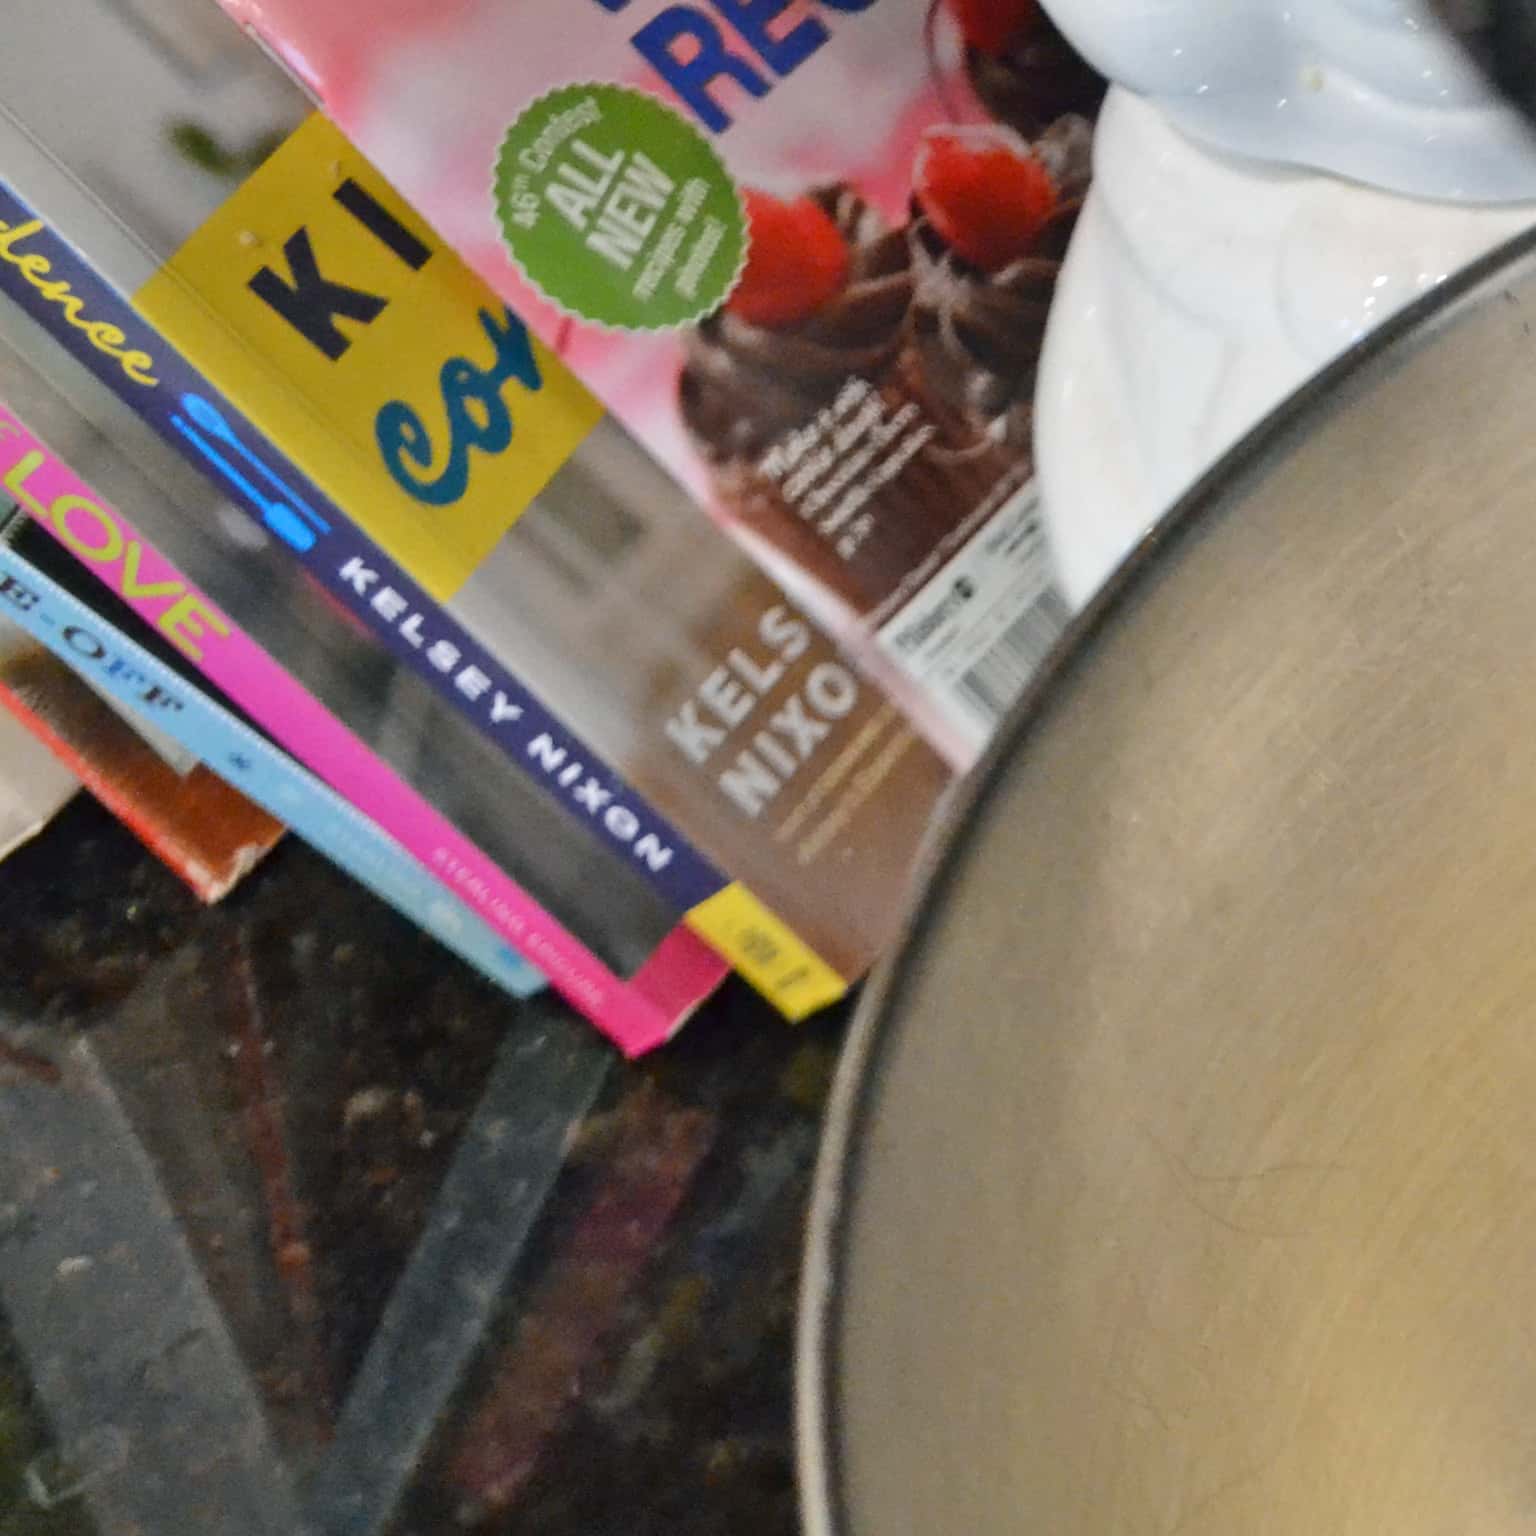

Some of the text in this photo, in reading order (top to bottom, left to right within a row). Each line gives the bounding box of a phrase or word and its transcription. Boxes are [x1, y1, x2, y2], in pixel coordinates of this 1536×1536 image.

[630, 0, 879, 134] RE
[544, 139, 625, 231] ALL
[585, 151, 675, 270] NEW
[247, 178, 433, 362] KI
[3, 449, 232, 662] LOVE
[338, 556, 525, 724] KELSEY
[526, 732, 675, 872] NIXON
[663, 604, 810, 767] KELS
[718, 661, 859, 819] NIXO
